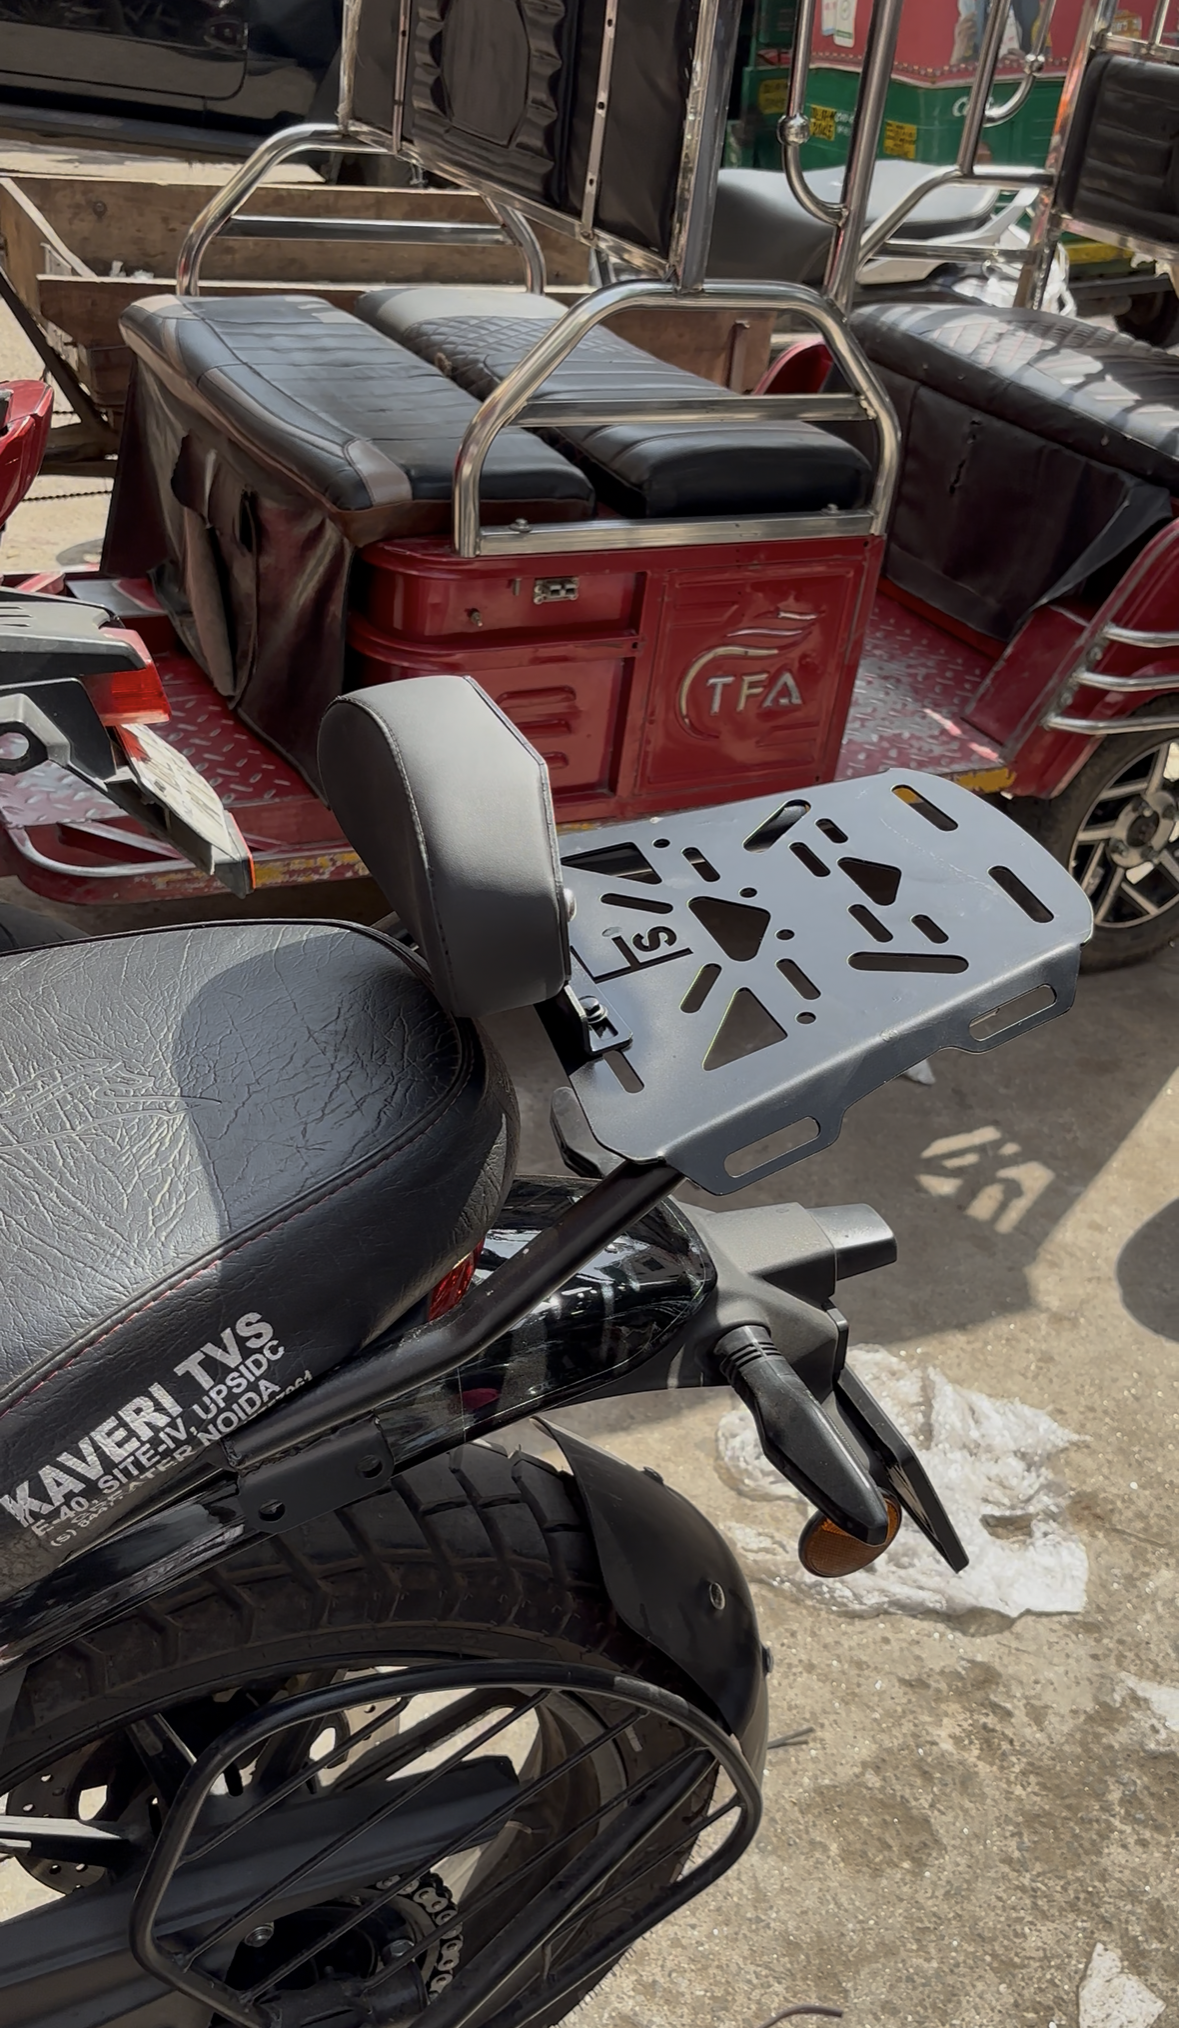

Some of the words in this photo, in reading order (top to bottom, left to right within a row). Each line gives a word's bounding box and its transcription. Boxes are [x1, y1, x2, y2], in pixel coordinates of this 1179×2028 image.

[706, 671, 802, 715] TFA
[192, 1339, 285, 1421] UPSIDC
[196, 1378, 282, 1447] NOIDA
[0, 1382, 183, 1528] KAVERI
[172, 1311, 274, 1392] TVS
